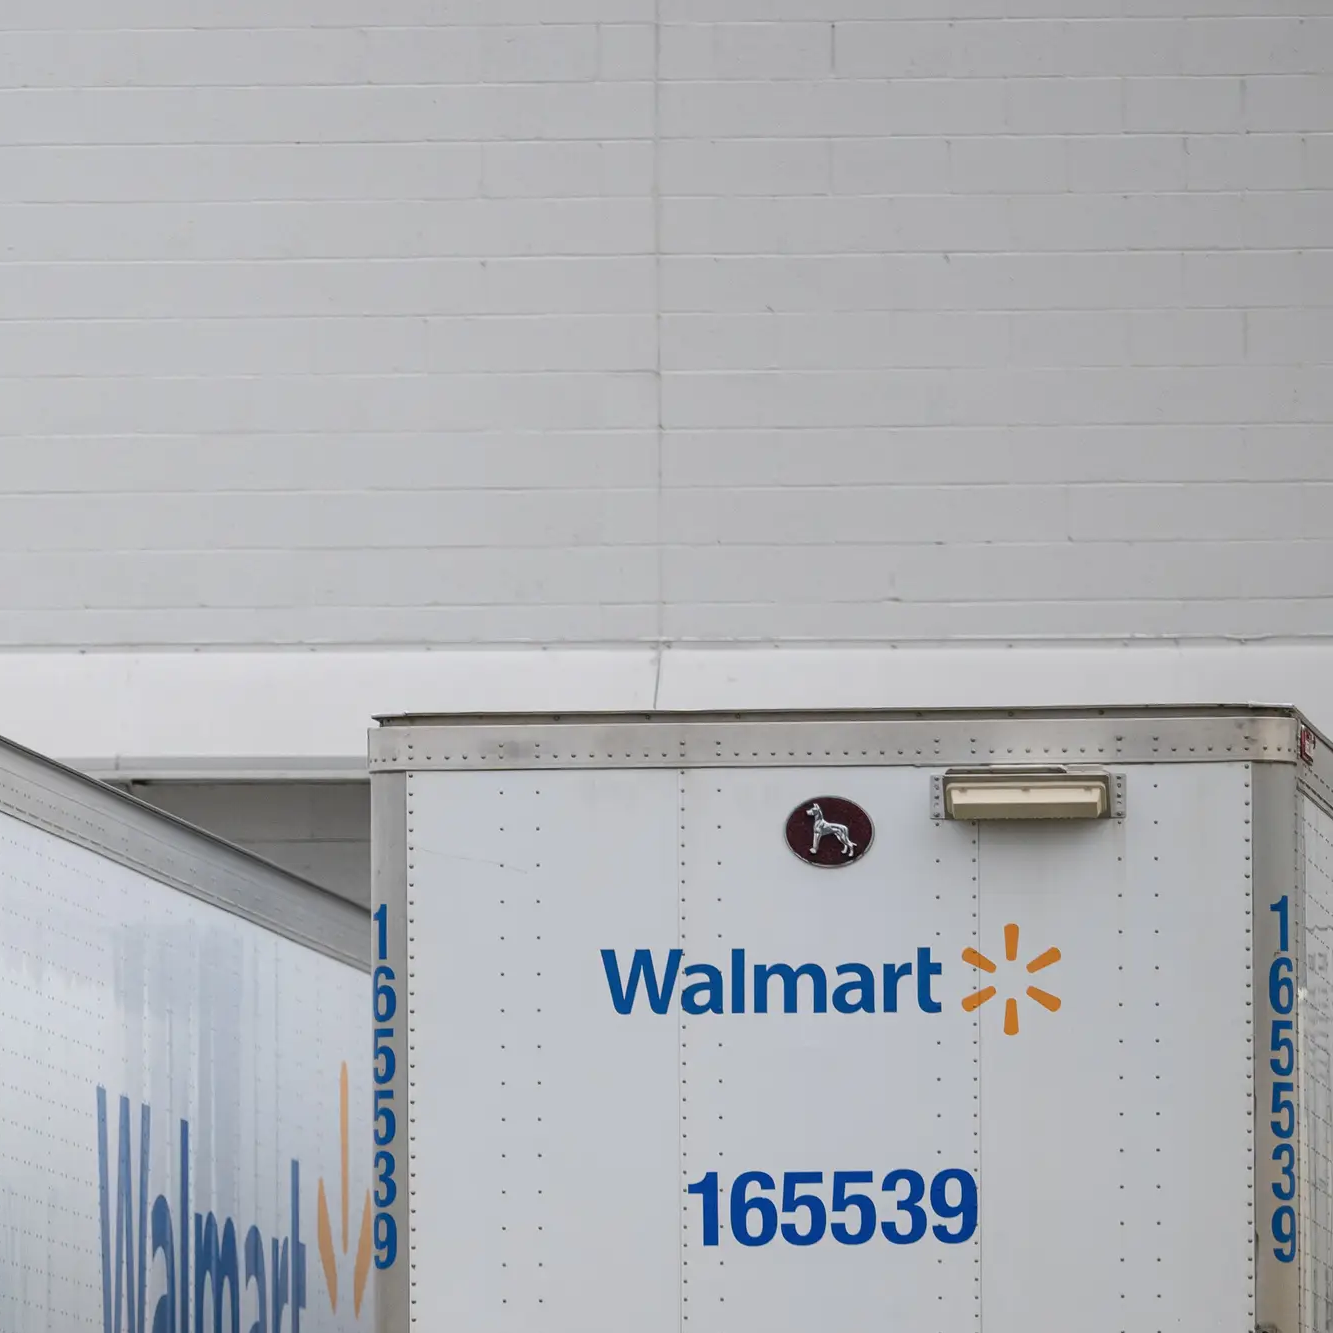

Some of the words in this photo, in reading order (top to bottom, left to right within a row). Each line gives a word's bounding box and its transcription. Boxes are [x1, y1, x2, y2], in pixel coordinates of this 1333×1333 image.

[372, 904, 397, 1270] 165539
[600, 947, 943, 1016] Walmart
[1269, 896, 1296, 1264] 165539
[688, 1168, 979, 1248] 165539
